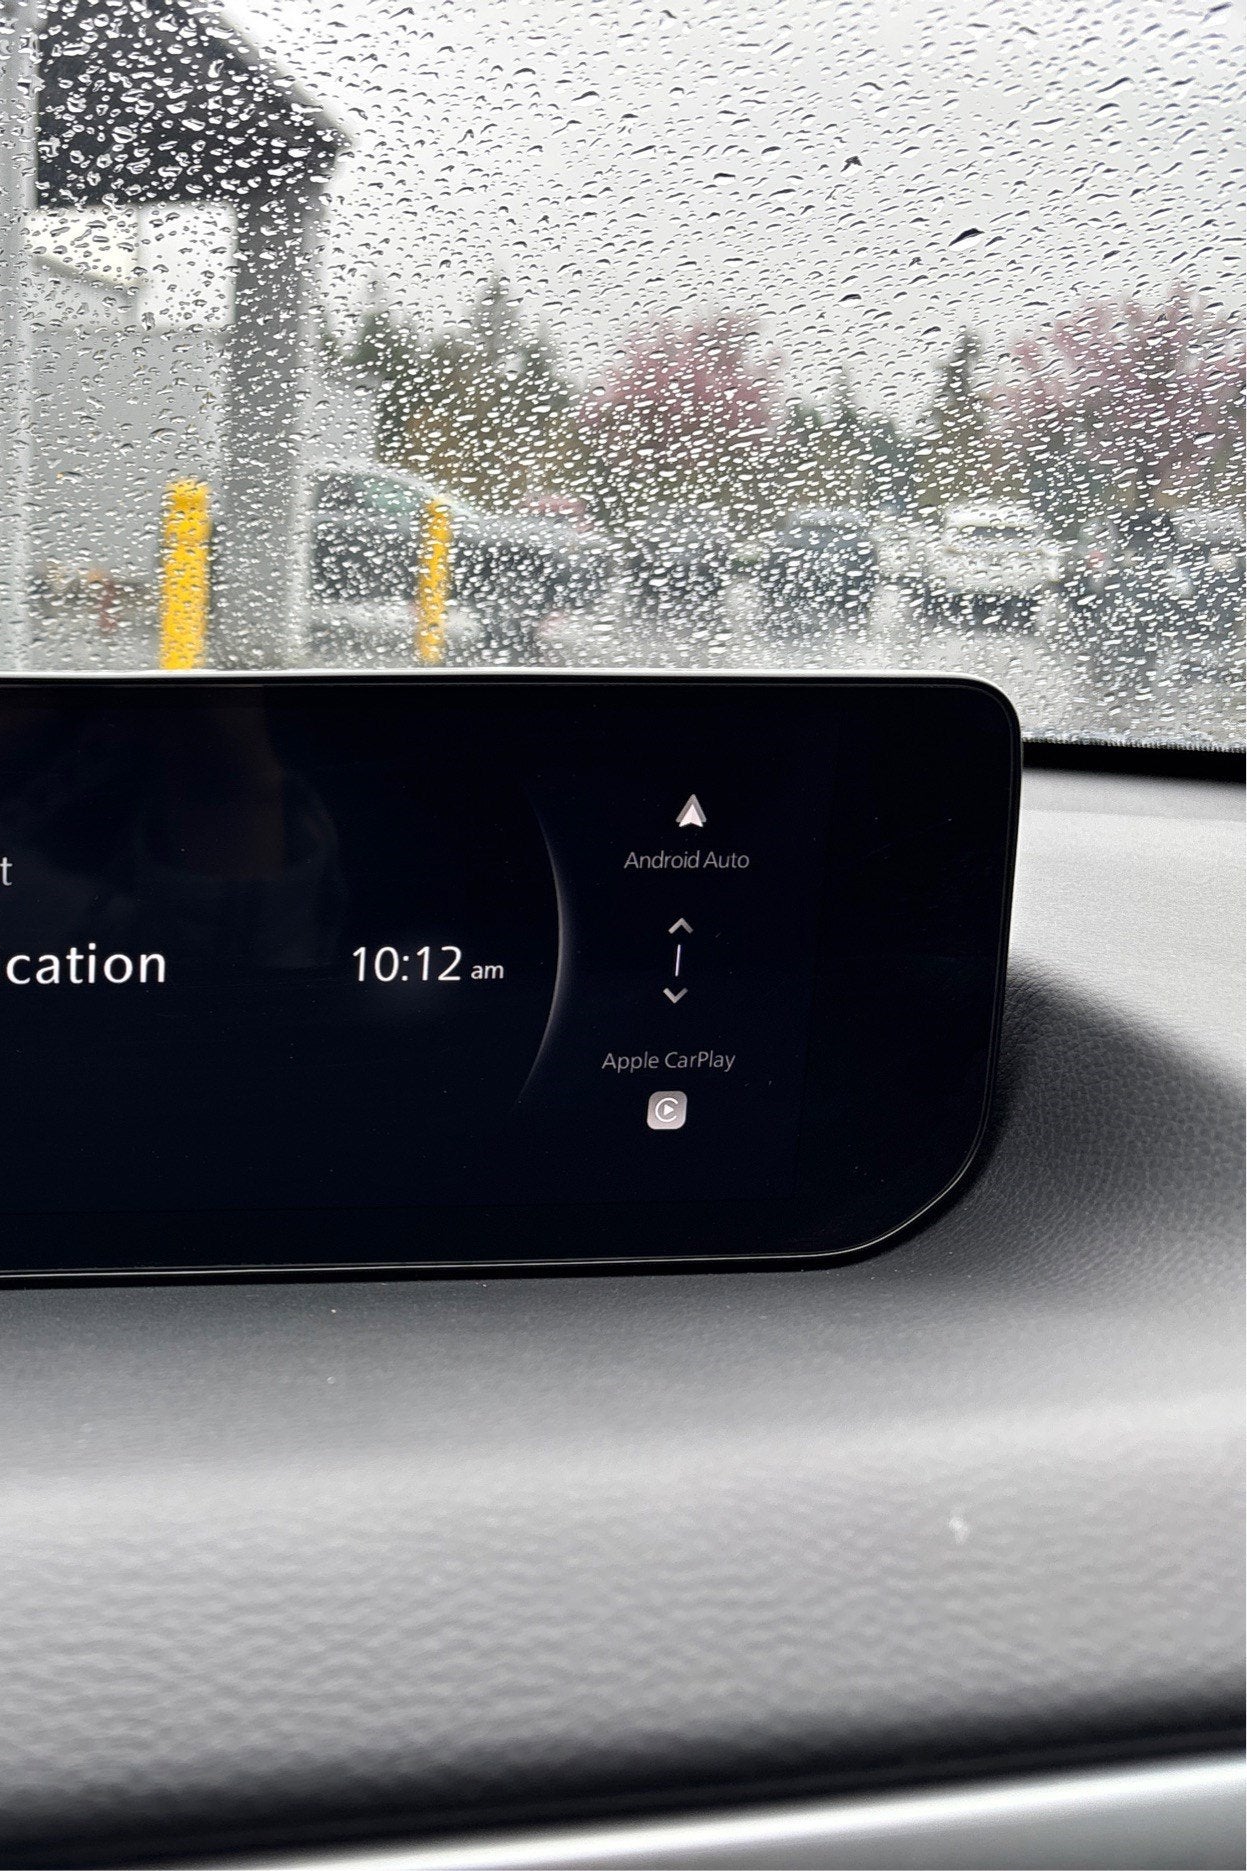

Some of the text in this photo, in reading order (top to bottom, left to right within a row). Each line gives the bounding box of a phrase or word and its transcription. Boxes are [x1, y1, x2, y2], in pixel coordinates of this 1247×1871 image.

[624, 850, 750, 869] Android Auto
[352, 945, 504, 982] 10:12 am
[601, 1050, 736, 1074] Apple CarPlay
